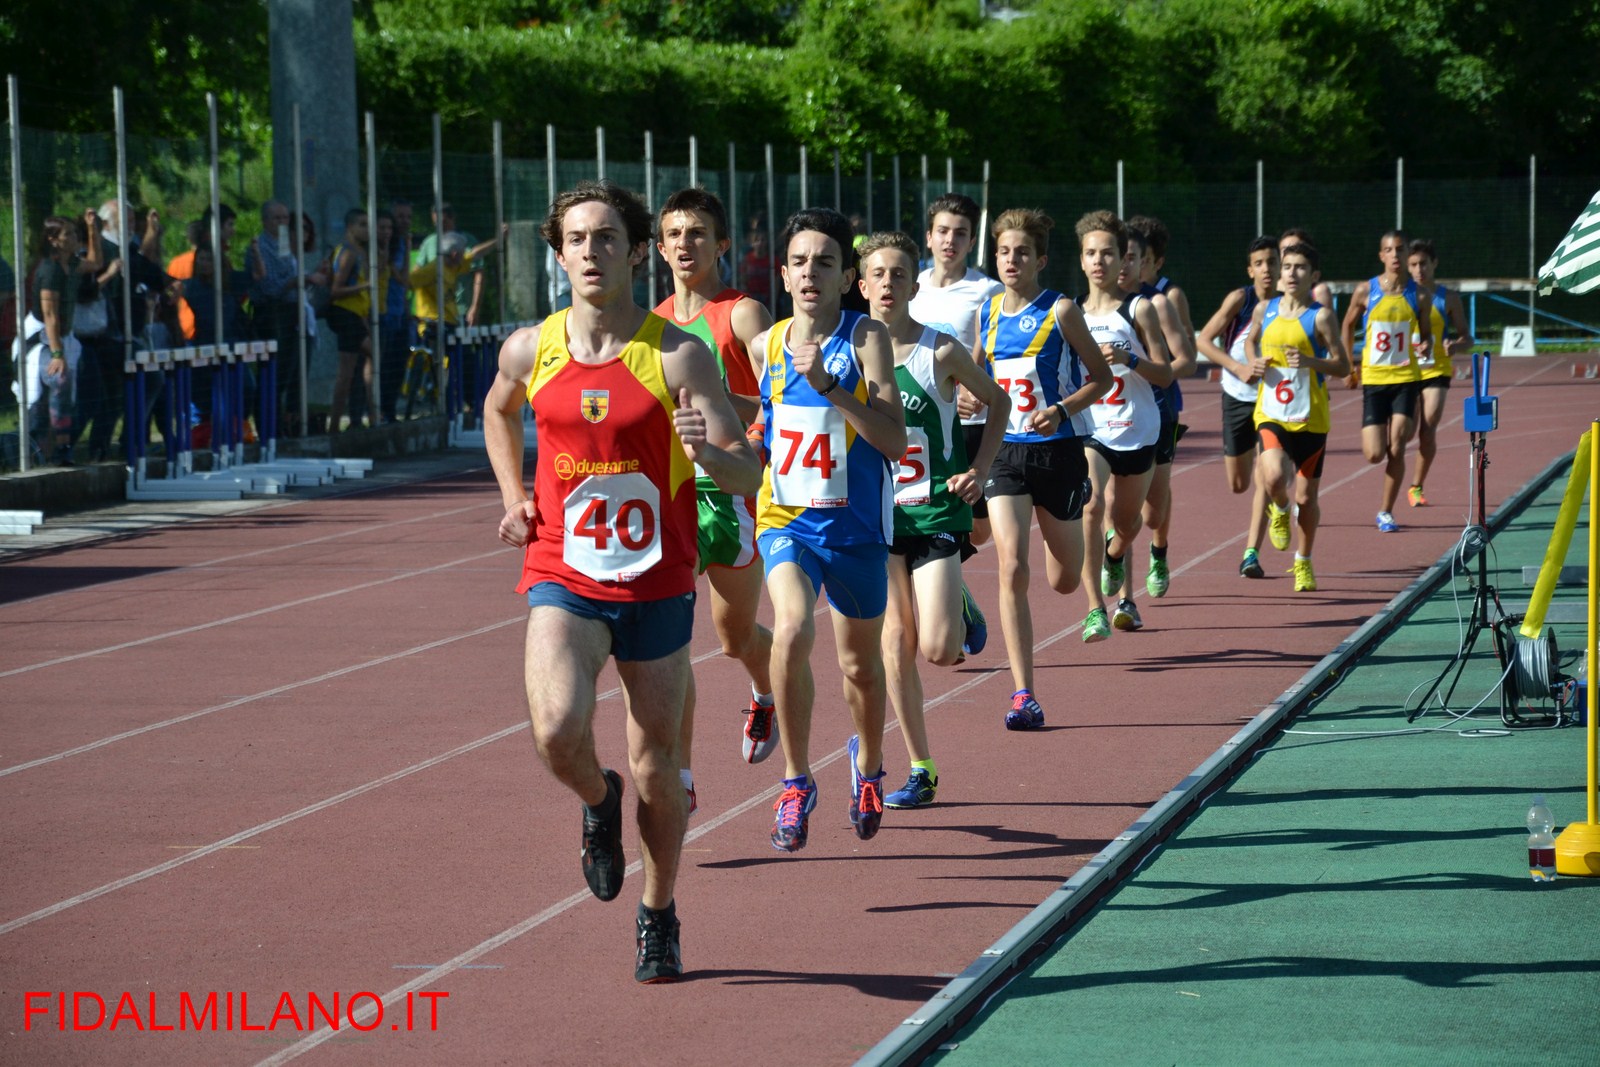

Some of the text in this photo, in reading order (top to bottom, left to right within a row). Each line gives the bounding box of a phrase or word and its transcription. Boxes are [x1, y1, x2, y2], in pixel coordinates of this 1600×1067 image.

[1376, 331, 1405, 353] 81
[1513, 332, 1525, 349] 2
[900, 390, 928, 414] RDI
[1275, 380, 1294, 404] 6
[576, 458, 640, 474] duemme
[778, 429, 837, 479] 74
[897, 446, 925, 484] 5
[573, 498, 655, 552] 40
